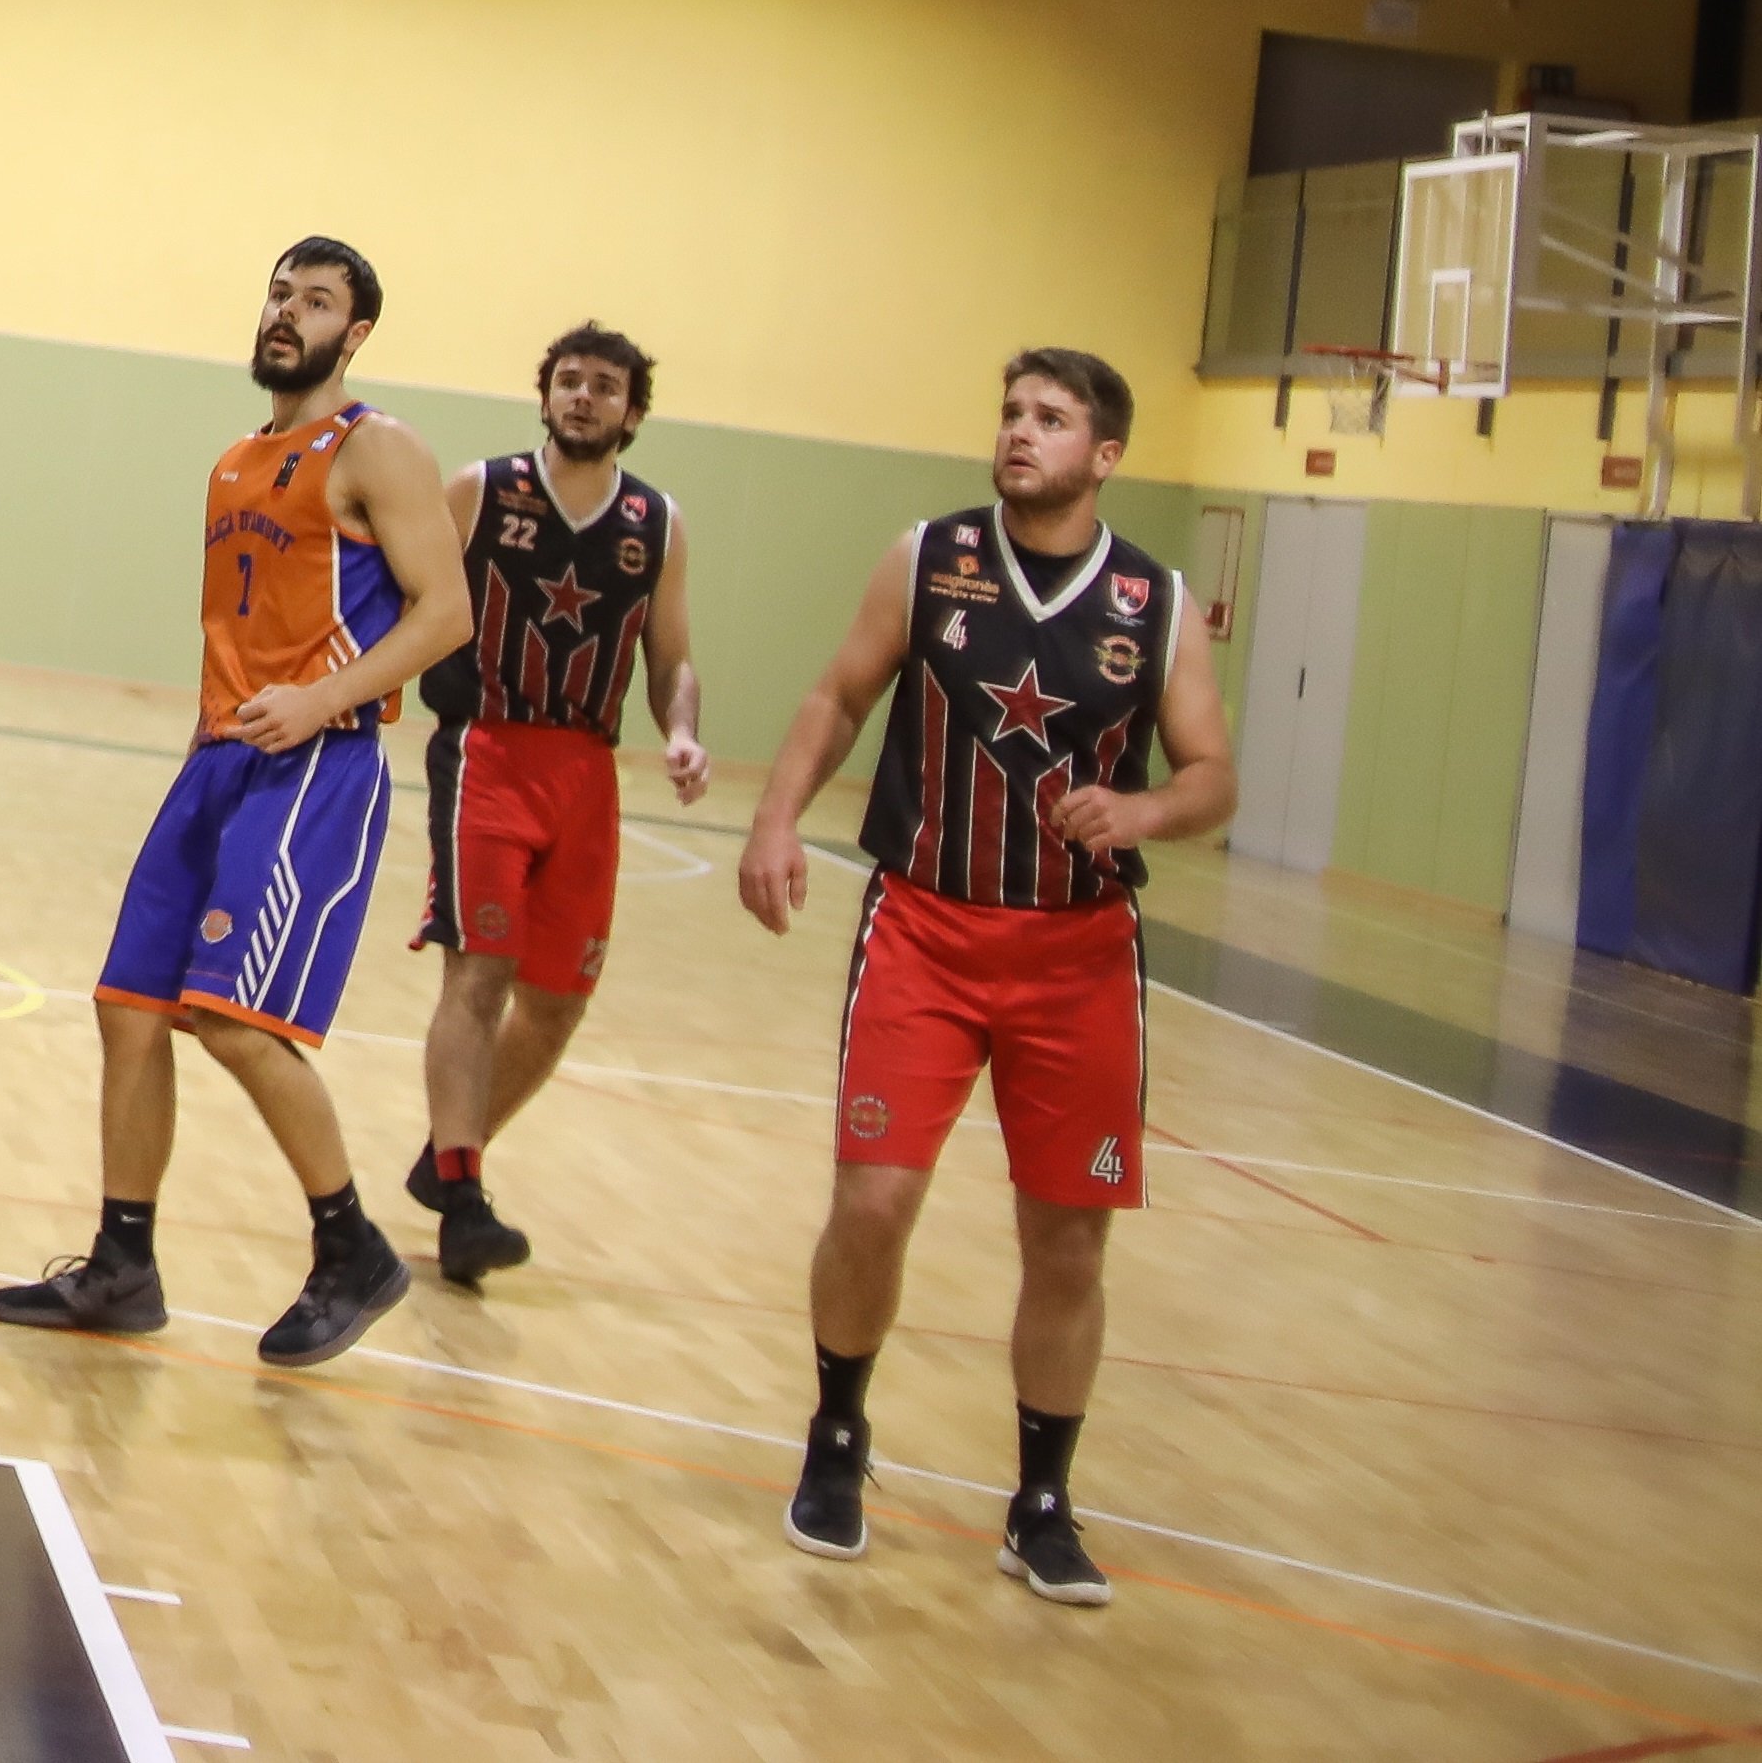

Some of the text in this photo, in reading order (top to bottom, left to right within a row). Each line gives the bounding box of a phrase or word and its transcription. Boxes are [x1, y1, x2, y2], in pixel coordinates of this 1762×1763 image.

[499, 512, 539, 552] 22
[942, 609, 968, 651] 4
[1090, 1136, 1125, 1184] 4
